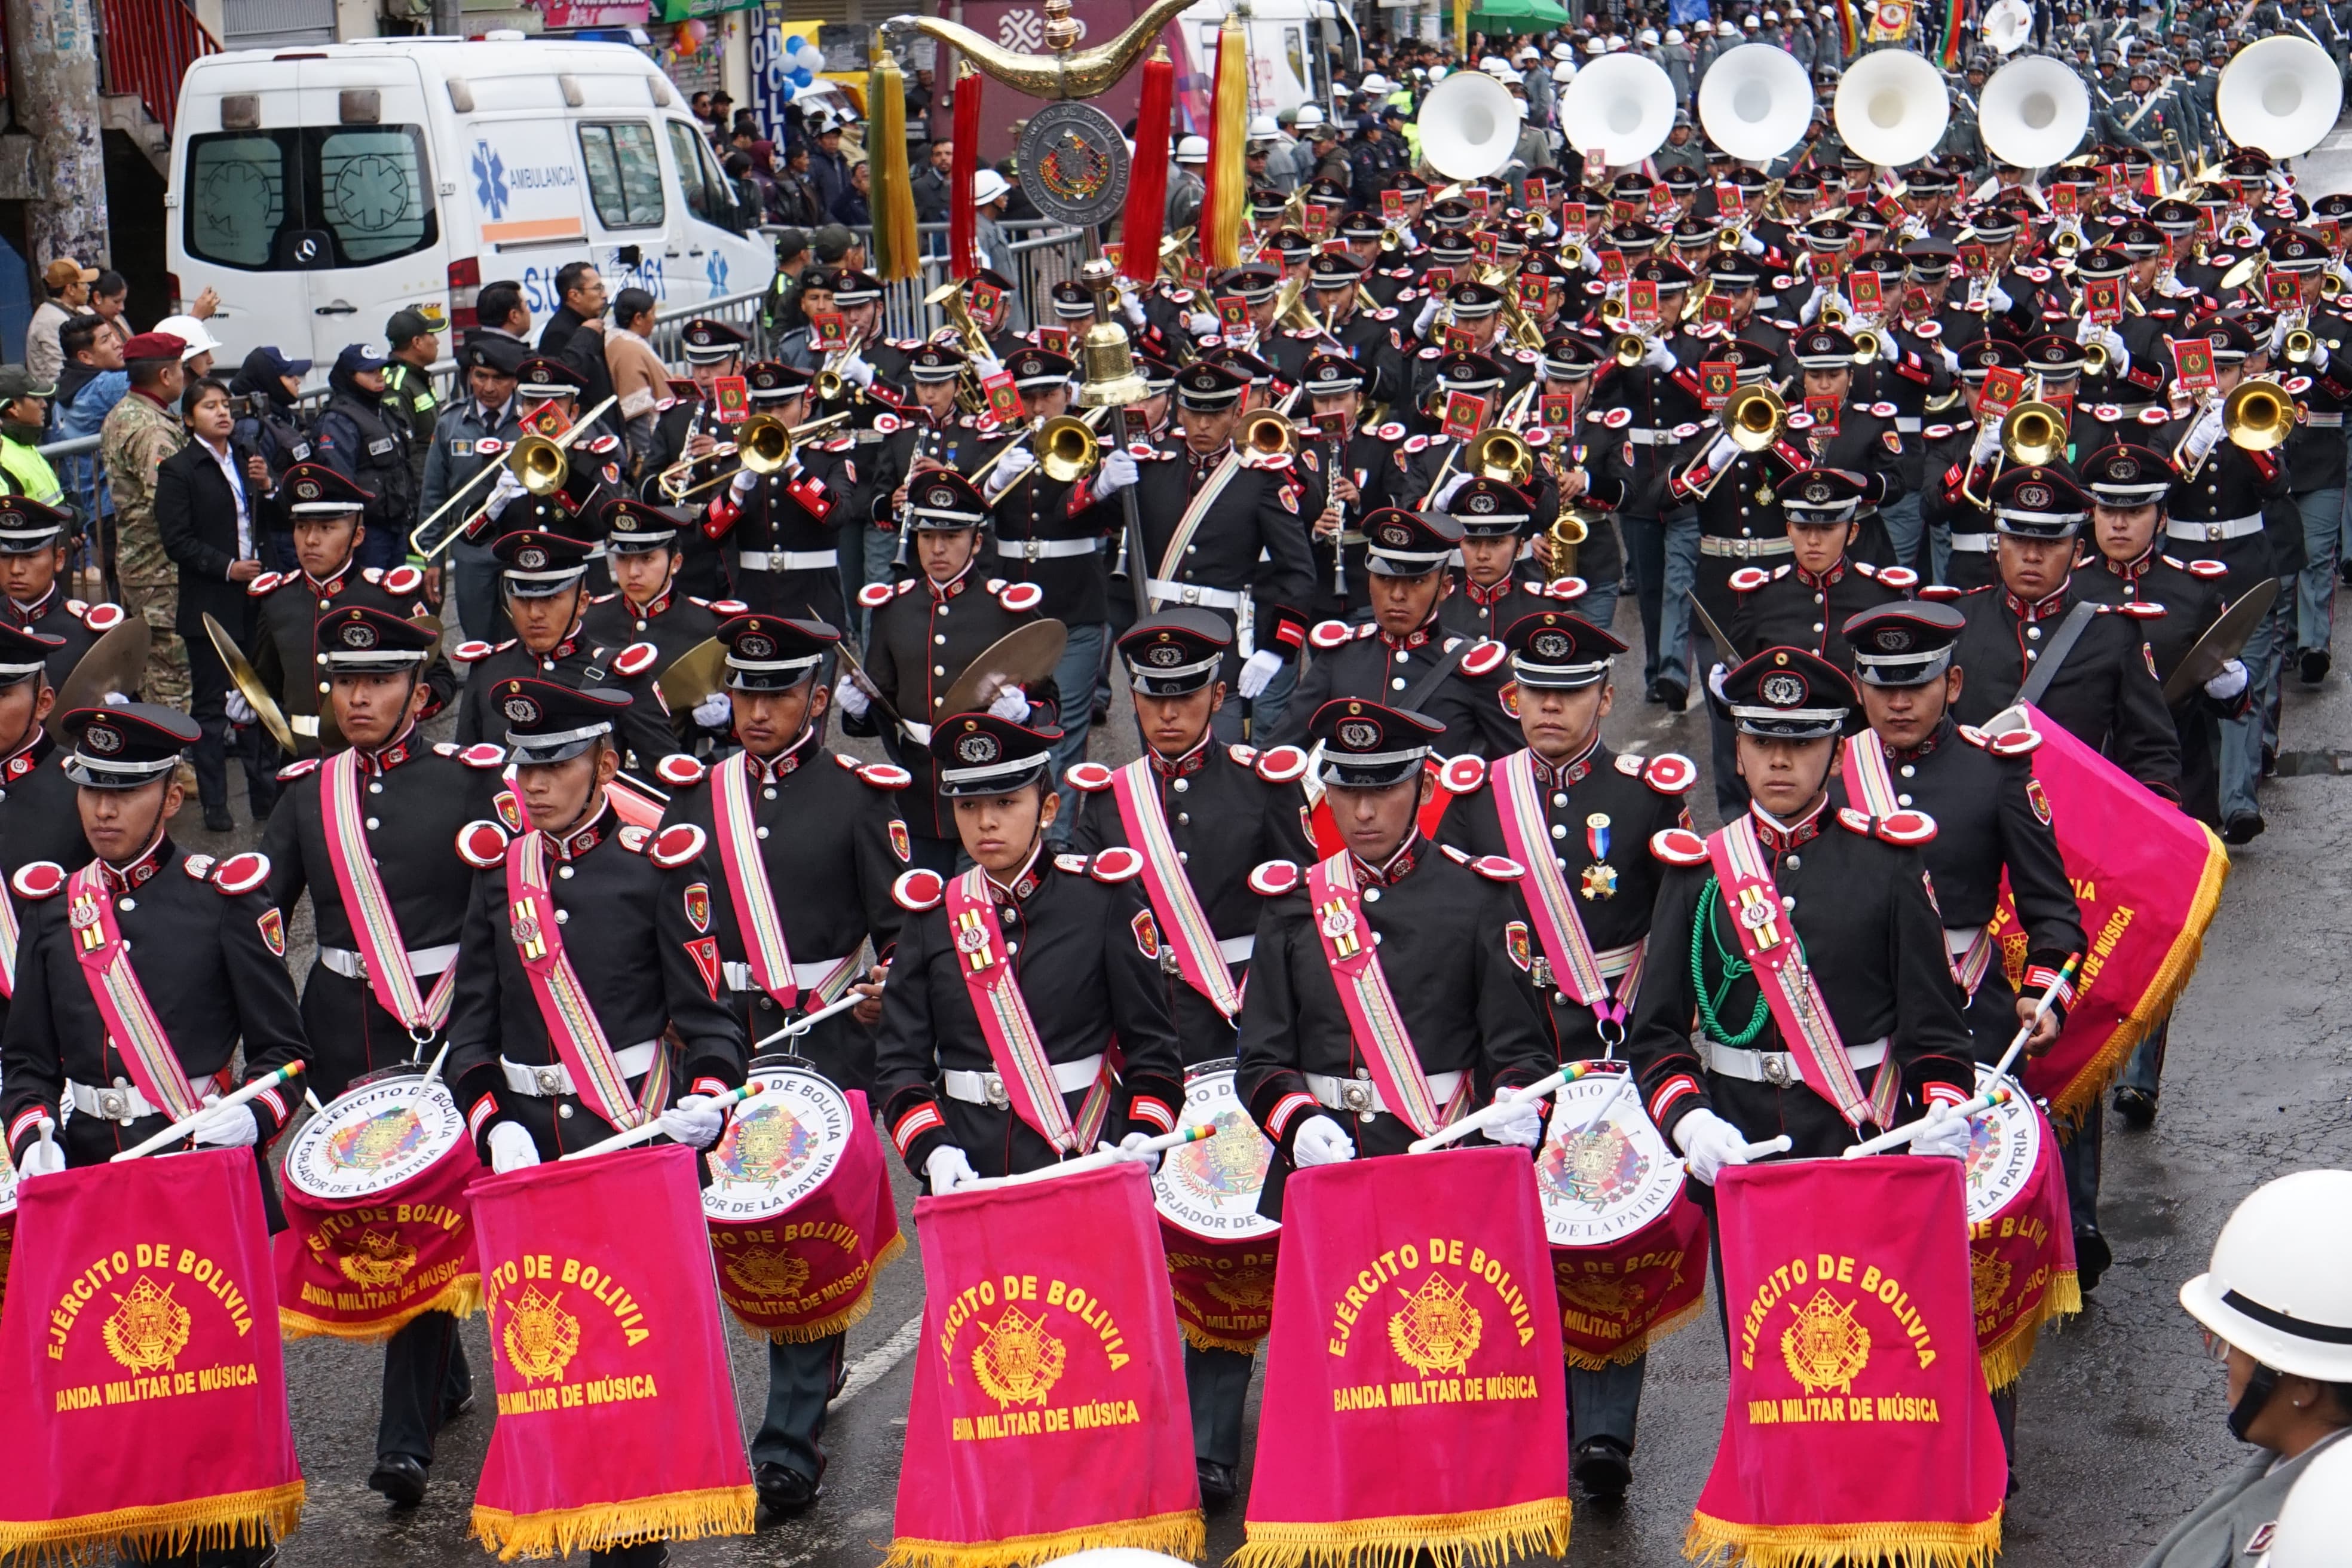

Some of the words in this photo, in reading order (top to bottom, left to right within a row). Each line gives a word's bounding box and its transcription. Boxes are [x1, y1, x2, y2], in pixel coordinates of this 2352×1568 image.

[510, 166, 577, 189] AMBULANCIA
[2093, 905, 2135, 959] MÚSICA
[2082, 952, 2105, 978] DE
[432, 1092, 458, 1140] BOLIVIA
[770, 1078, 798, 1092] DE
[800, 1080, 841, 1142] BOLIVIA
[298, 1141, 329, 1191] FORJADOR
[329, 1184, 354, 1194] DE
[356, 1180, 378, 1192] LA
[383, 1147, 442, 1185] PATRIA
[731, 1200, 756, 1214] DE
[760, 1195, 785, 1211] LA
[787, 1152, 837, 1201] PATRIA
[1977, 1189, 2003, 1209] LA
[1999, 1128, 2028, 1188] PATRIA
[356, 1208, 389, 1224] DE
[396, 1204, 466, 1240] BOLIV
[1233, 1214, 1258, 1229] DE
[1554, 1221, 1580, 1237] DE
[1587, 1221, 1612, 1236] LA
[1616, 1178, 1672, 1228] PATRIA
[745, 1229, 776, 1244] DE
[783, 1220, 861, 1255] BOLIVIA
[1244, 1254, 1274, 1267] DE
[1583, 1261, 1615, 1273] DE
[48, 1250, 130, 1361] EJÉRCITO
[136, 1243, 170, 1268] DE
[176, 1248, 253, 1338] BOLIVIA
[337, 1288, 398, 1310] MILITAR
[400, 1279, 416, 1301] DE
[523, 1254, 553, 1279] DE
[561, 1257, 651, 1348] BOLIVIA
[739, 1298, 800, 1316] MILITAR
[799, 1293, 824, 1312] DE
[820, 1258, 871, 1301] MÚSICA
[1328, 1244, 1420, 1359] EJÉRCITO
[1429, 1238, 1464, 1266] DE
[1469, 1247, 1535, 1348] BOLIVIA
[1002, 1275, 1038, 1301] DE
[1046, 1279, 1131, 1373] BOLIVIA
[1206, 1314, 1268, 1332] MILITAR
[1564, 1309, 1623, 1340] MILITAR
[1741, 1258, 1808, 1371] EJÉRCITO
[1817, 1254, 1855, 1284] DE
[1860, 1264, 1937, 1371] BOLIVIA
[104, 1375, 172, 1405] MILITAR
[173, 1371, 197, 1396] DE
[198, 1362, 259, 1392] MÚSICA
[509, 1387, 559, 1415] MILITAR
[560, 1383, 584, 1408] DE
[586, 1373, 658, 1405] MÚSICA
[1333, 1384, 1388, 1412] BANDA
[1389, 1378, 1463, 1407] MILITAR
[1464, 1377, 1484, 1402] DE
[1486, 1371, 1539, 1401] MÚSICA
[976, 1410, 1042, 1441] MILITAR
[1044, 1407, 1071, 1434] DE
[1073, 1398, 1141, 1430] MÚSICA
[1781, 1397, 1846, 1423] MILITAR
[1849, 1397, 1874, 1422] DE
[1877, 1391, 1940, 1423] MÚSICA
